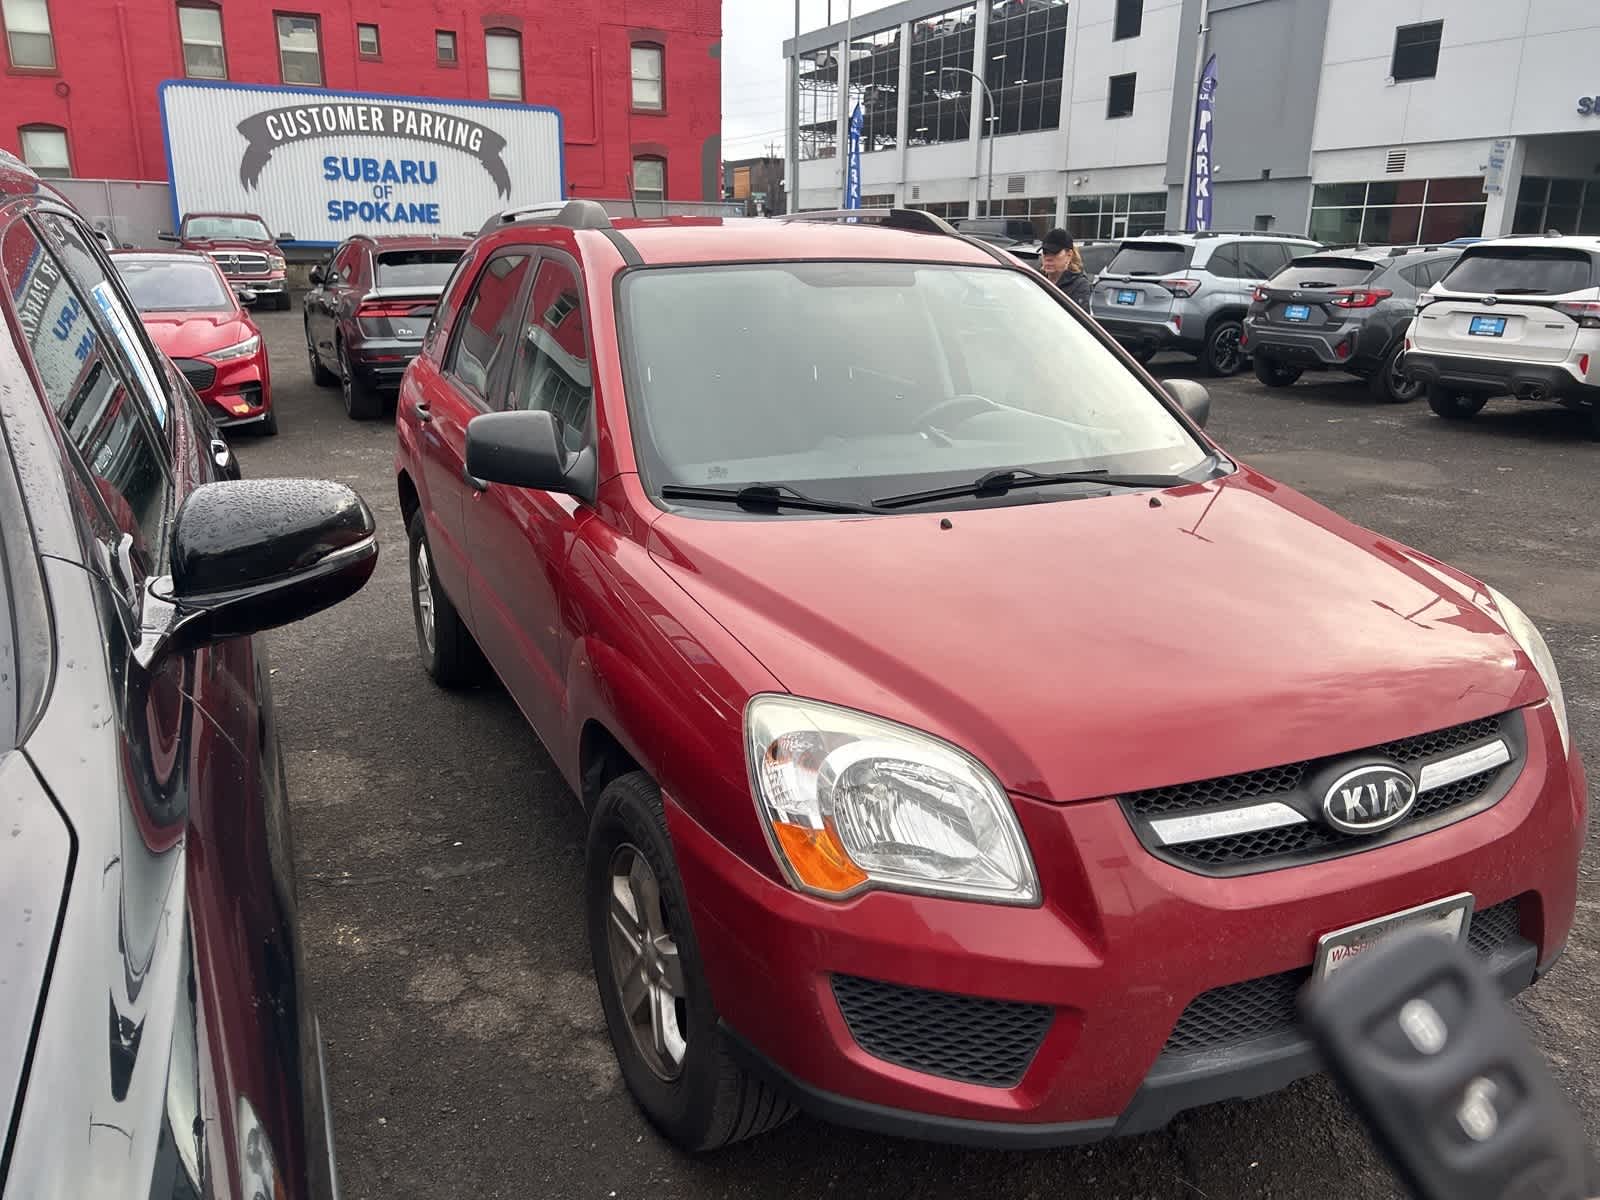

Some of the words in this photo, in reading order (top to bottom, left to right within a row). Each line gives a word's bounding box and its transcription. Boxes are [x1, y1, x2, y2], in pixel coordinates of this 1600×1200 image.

[265, 105, 385, 141] CUSTOMER
[392, 108, 484, 152] PARKING
[323, 156, 438, 184] SUBARU
[373, 185, 393, 199] OF
[327, 200, 440, 224] SPOKANE
[1341, 778, 1406, 820] KIA
